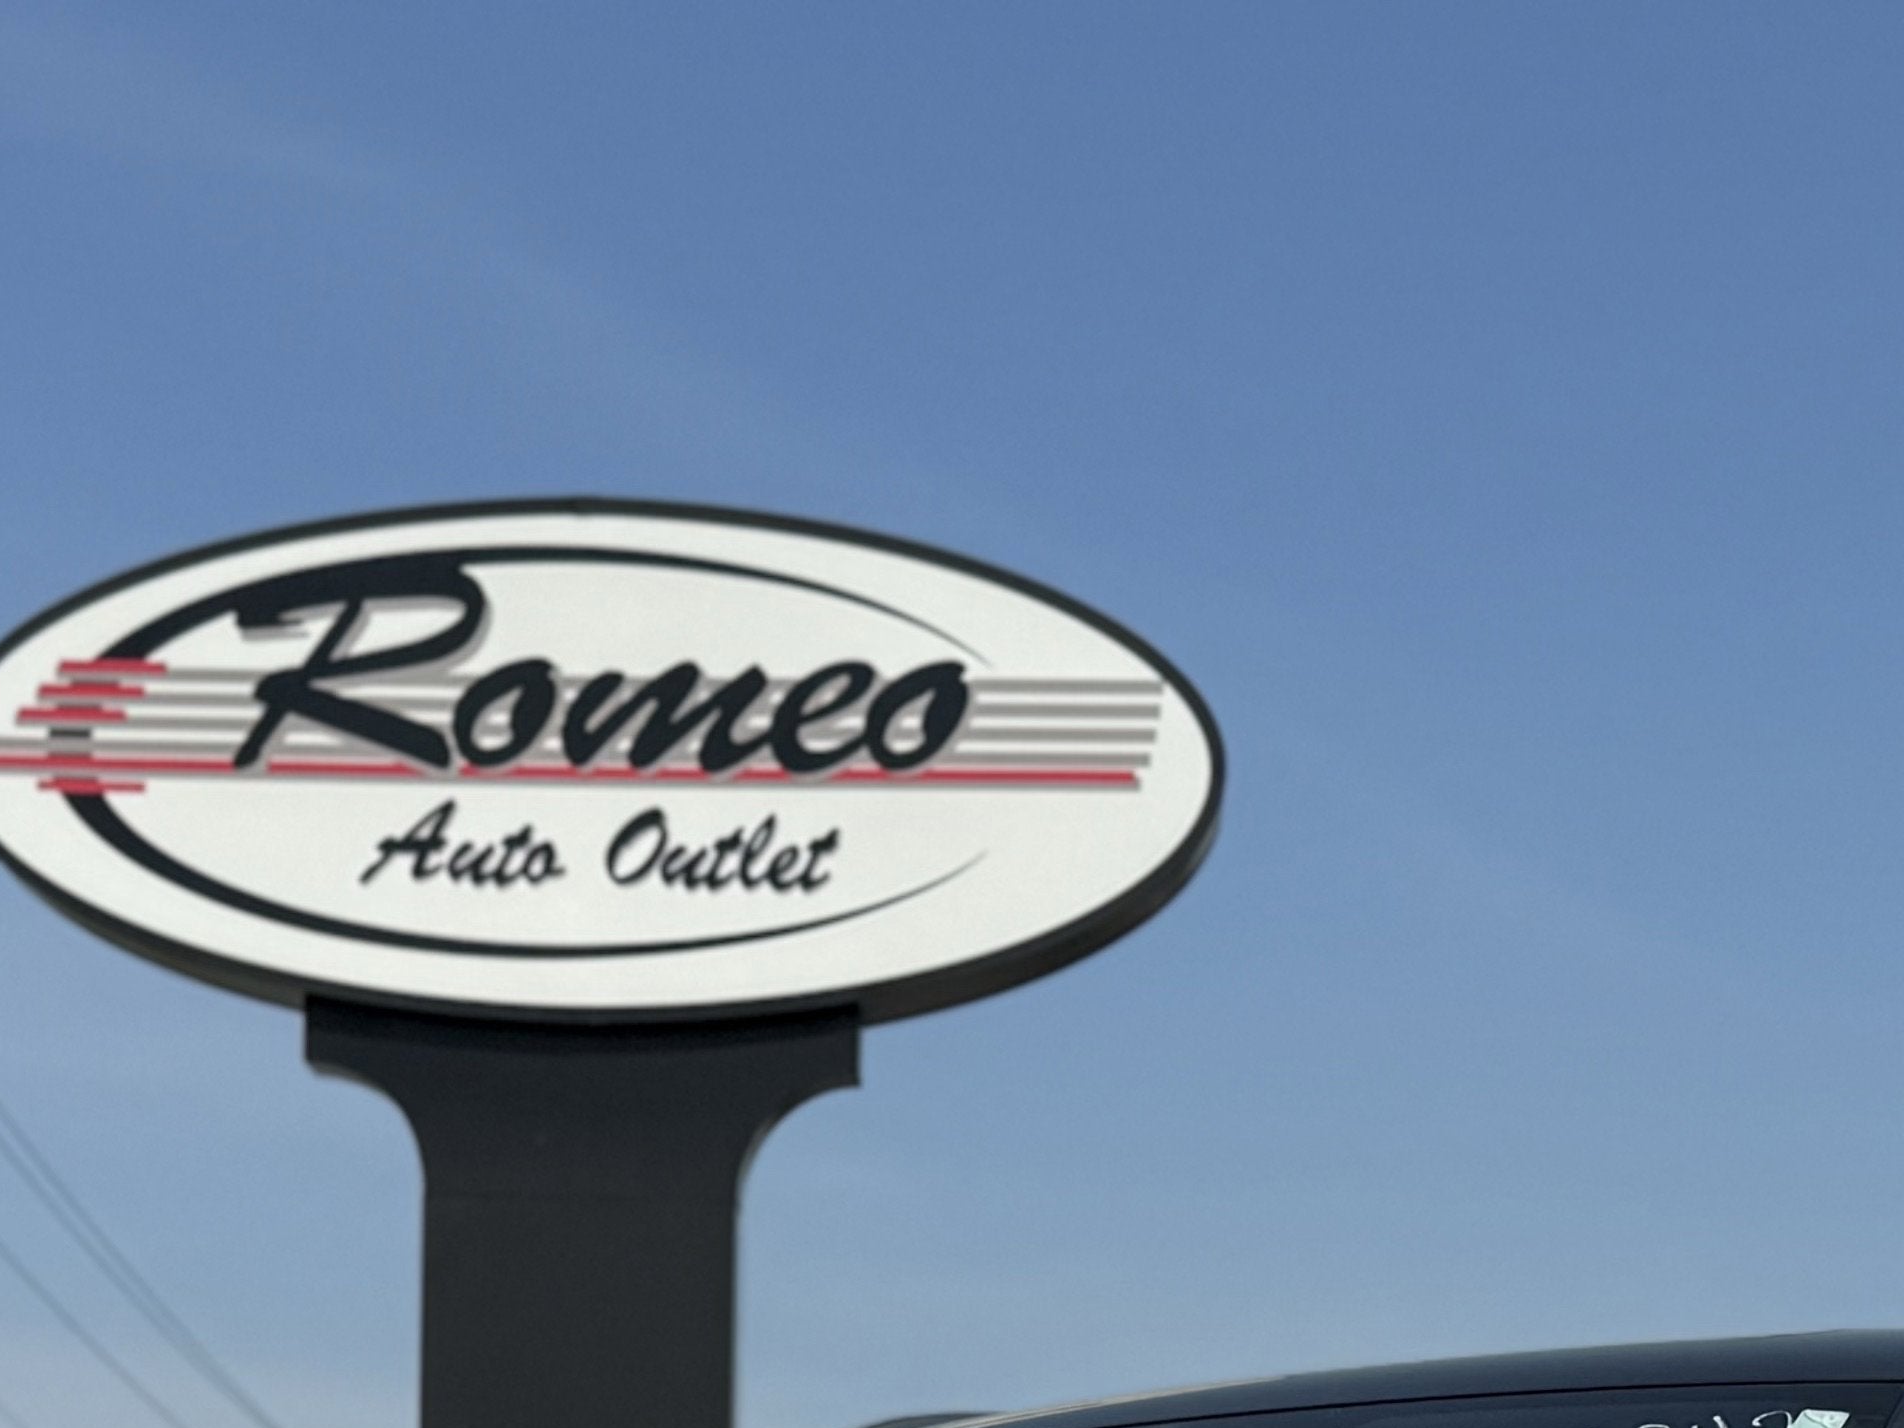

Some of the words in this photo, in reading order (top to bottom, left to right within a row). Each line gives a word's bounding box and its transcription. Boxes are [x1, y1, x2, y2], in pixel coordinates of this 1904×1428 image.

[232, 549, 970, 776] Romeo
[358, 797, 567, 887] Auto
[605, 805, 841, 895] Outlet
